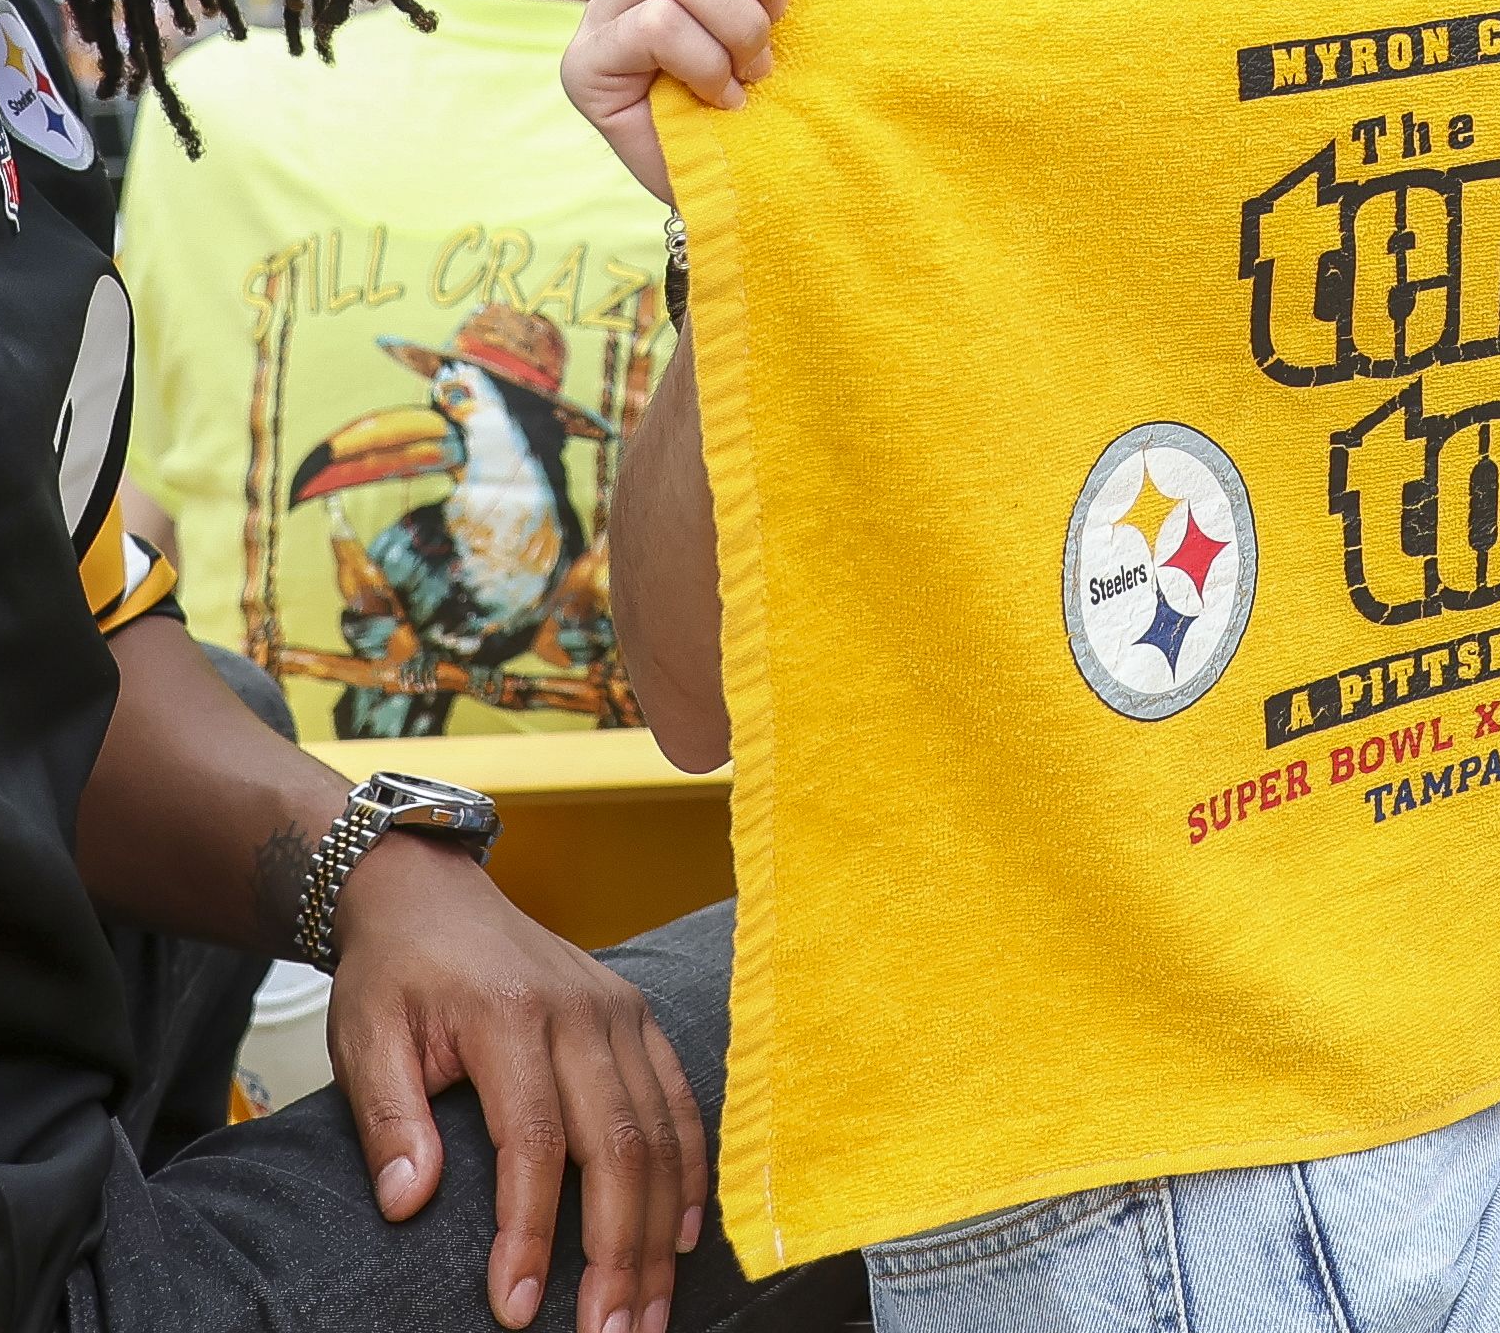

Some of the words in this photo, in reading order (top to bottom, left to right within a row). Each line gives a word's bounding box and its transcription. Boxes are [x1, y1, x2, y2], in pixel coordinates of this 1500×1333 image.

[1272, 23, 1452, 93] MYRON
[1352, 109, 1478, 167] The
[241, 224, 405, 340] STILL
[1089, 562, 1149, 606] Steelers
[1285, 684, 1316, 734] A
[1186, 760, 1313, 845] SUPER
[1329, 717, 1454, 787] BOWL
